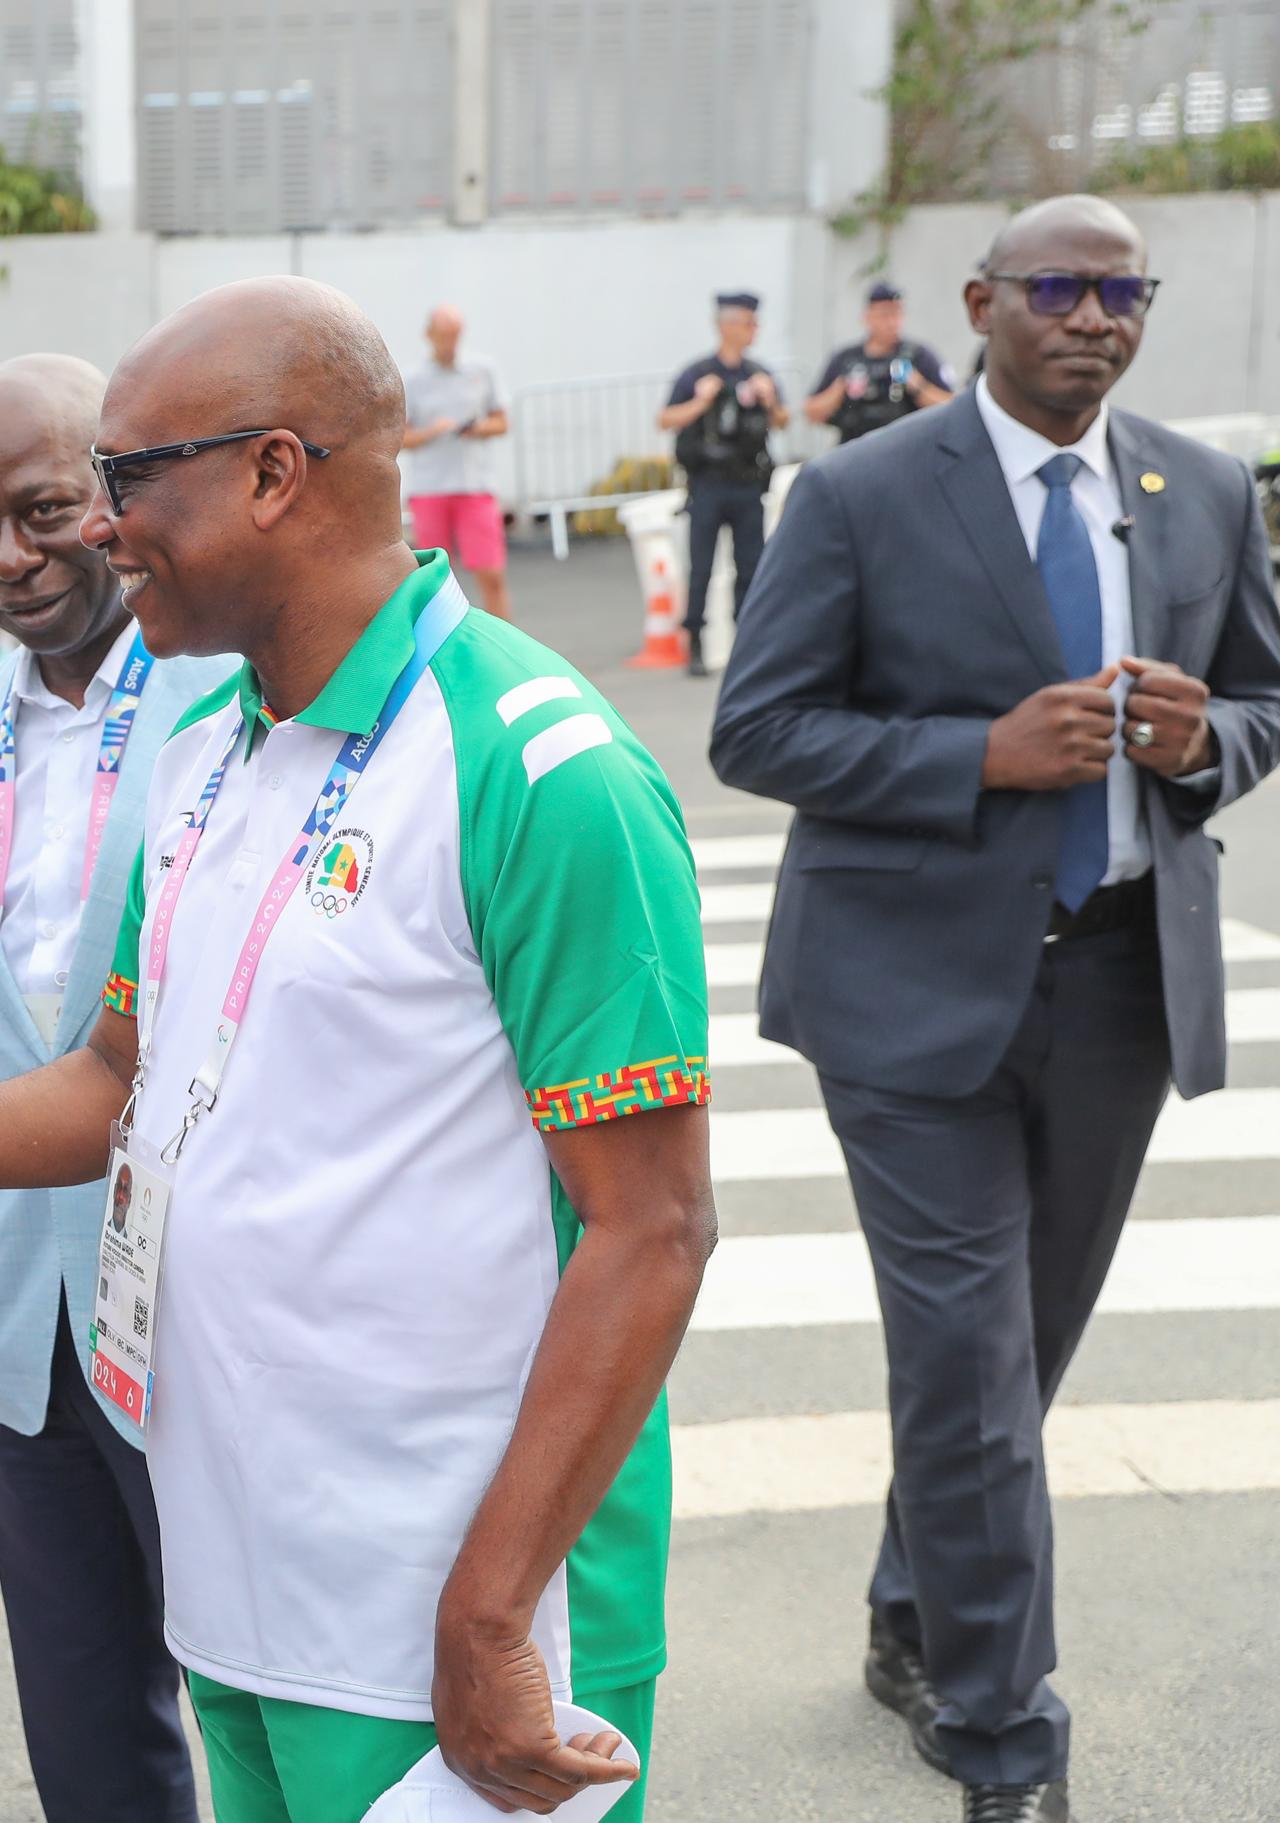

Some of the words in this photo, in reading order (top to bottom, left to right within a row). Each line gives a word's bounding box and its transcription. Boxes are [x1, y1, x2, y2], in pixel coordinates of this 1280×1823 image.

[124, 656, 146, 691] Atos
[229, 942, 259, 1008] PARIS
[256, 875, 293, 934] 2024
